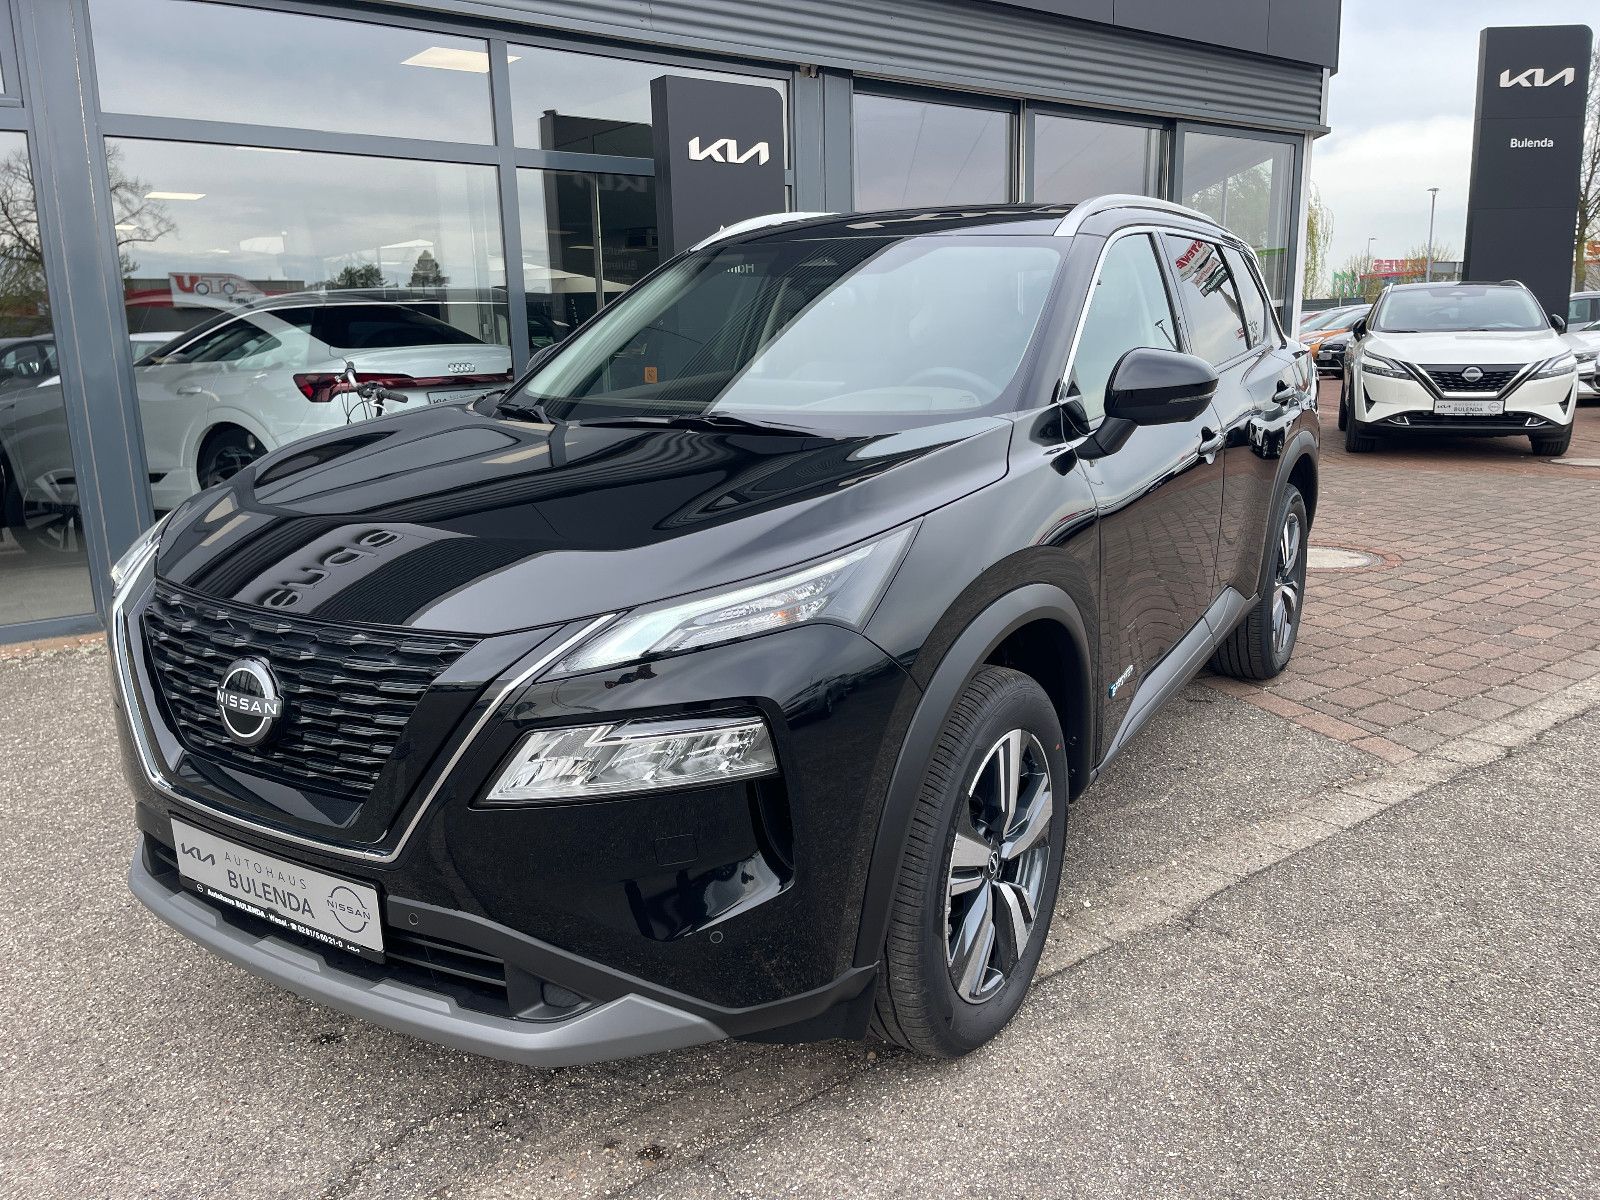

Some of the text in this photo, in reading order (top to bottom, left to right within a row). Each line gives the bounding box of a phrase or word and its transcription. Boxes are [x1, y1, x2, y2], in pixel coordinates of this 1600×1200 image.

[1510, 138, 1554, 148] Bulenda
[217, 689, 278, 715] NISSAN
[224, 851, 307, 890] AUTOHAUS
[207, 888, 236, 906] Autohaus
[235, 899, 266, 919] BULENDA
[226, 869, 316, 920] BULENDA
[326, 899, 371, 921] NISSAN
